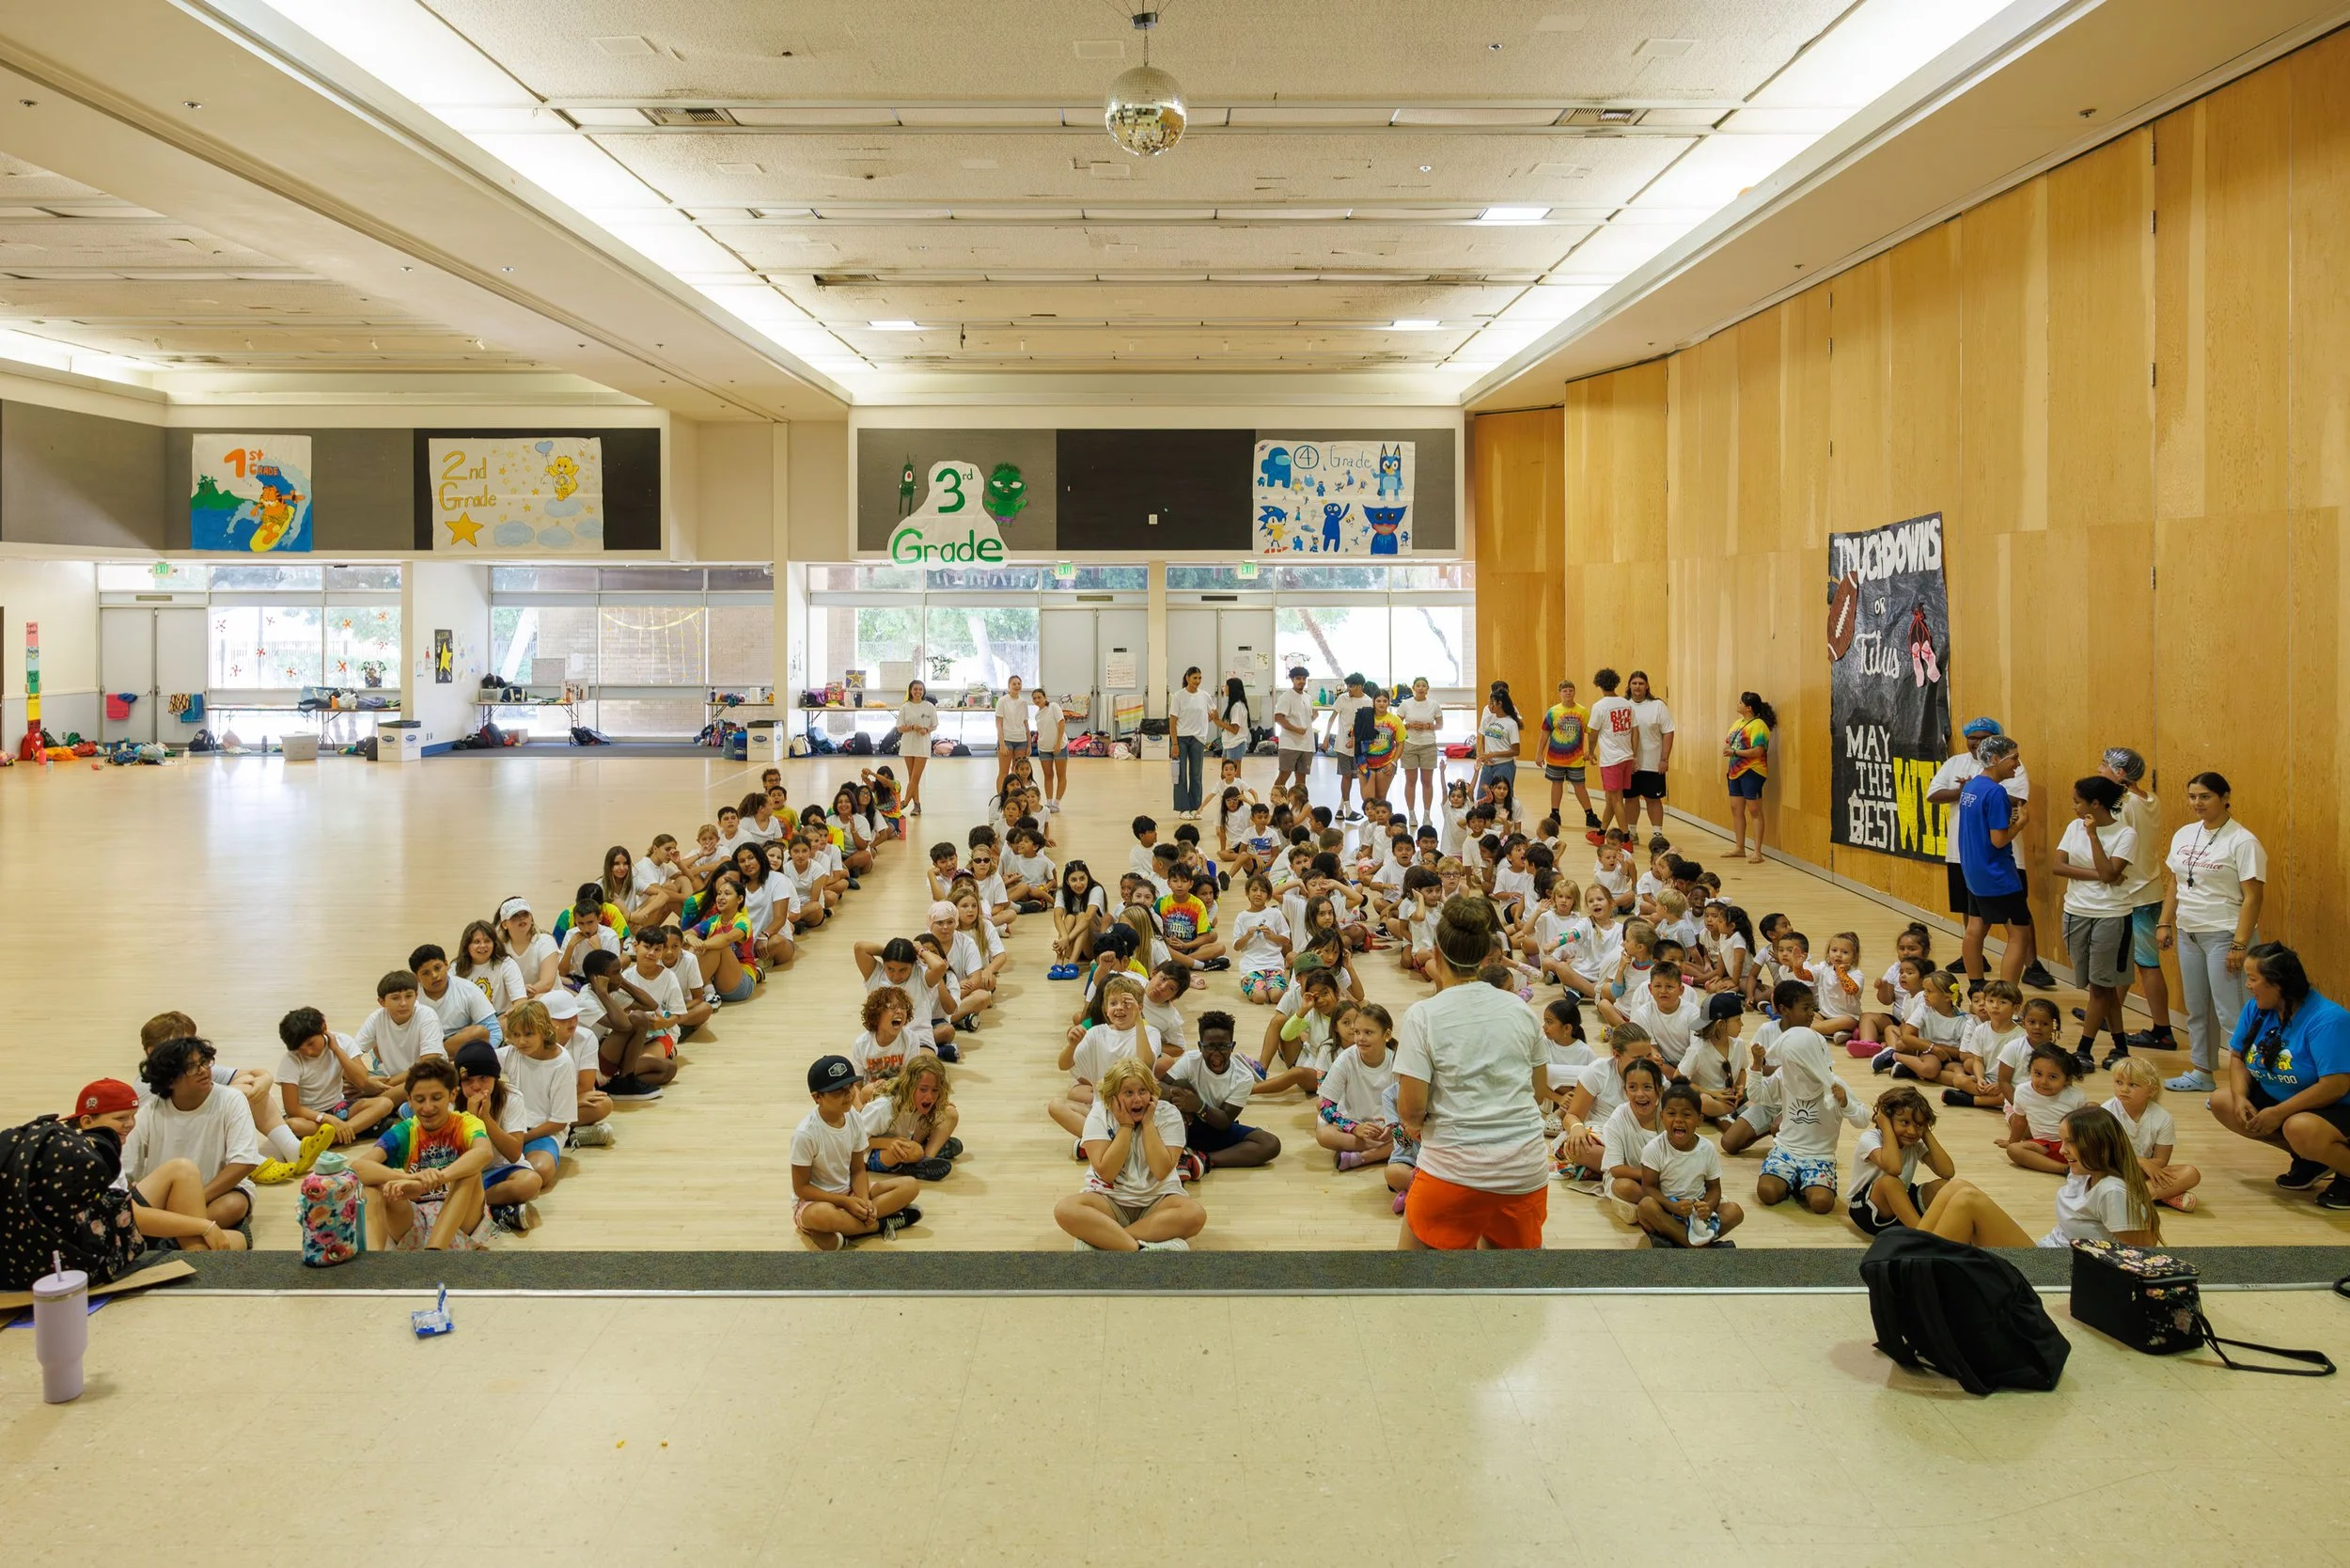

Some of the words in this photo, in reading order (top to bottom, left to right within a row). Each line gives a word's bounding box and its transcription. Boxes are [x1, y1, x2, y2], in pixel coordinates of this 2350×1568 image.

[224, 447, 264, 478] 1st
[442, 450, 487, 480] 2nd
[1329, 444, 1372, 468] Grade
[438, 481, 497, 511] Grade
[935, 467, 973, 513] 3rd
[892, 527, 1004, 564] Grade
[1834, 518, 1942, 585] TOUCHDOWNS
[155, 564, 169, 574] EXIT
[1058, 565, 1073, 574] EXIT
[1241, 564, 1255, 574] EXIT
[1874, 597, 1887, 615] OR
[1854, 629, 1900, 679] Tutus
[1845, 725, 1891, 762] MAY
[1855, 760, 1892, 799] THE
[1847, 789, 1898, 852] BEST
